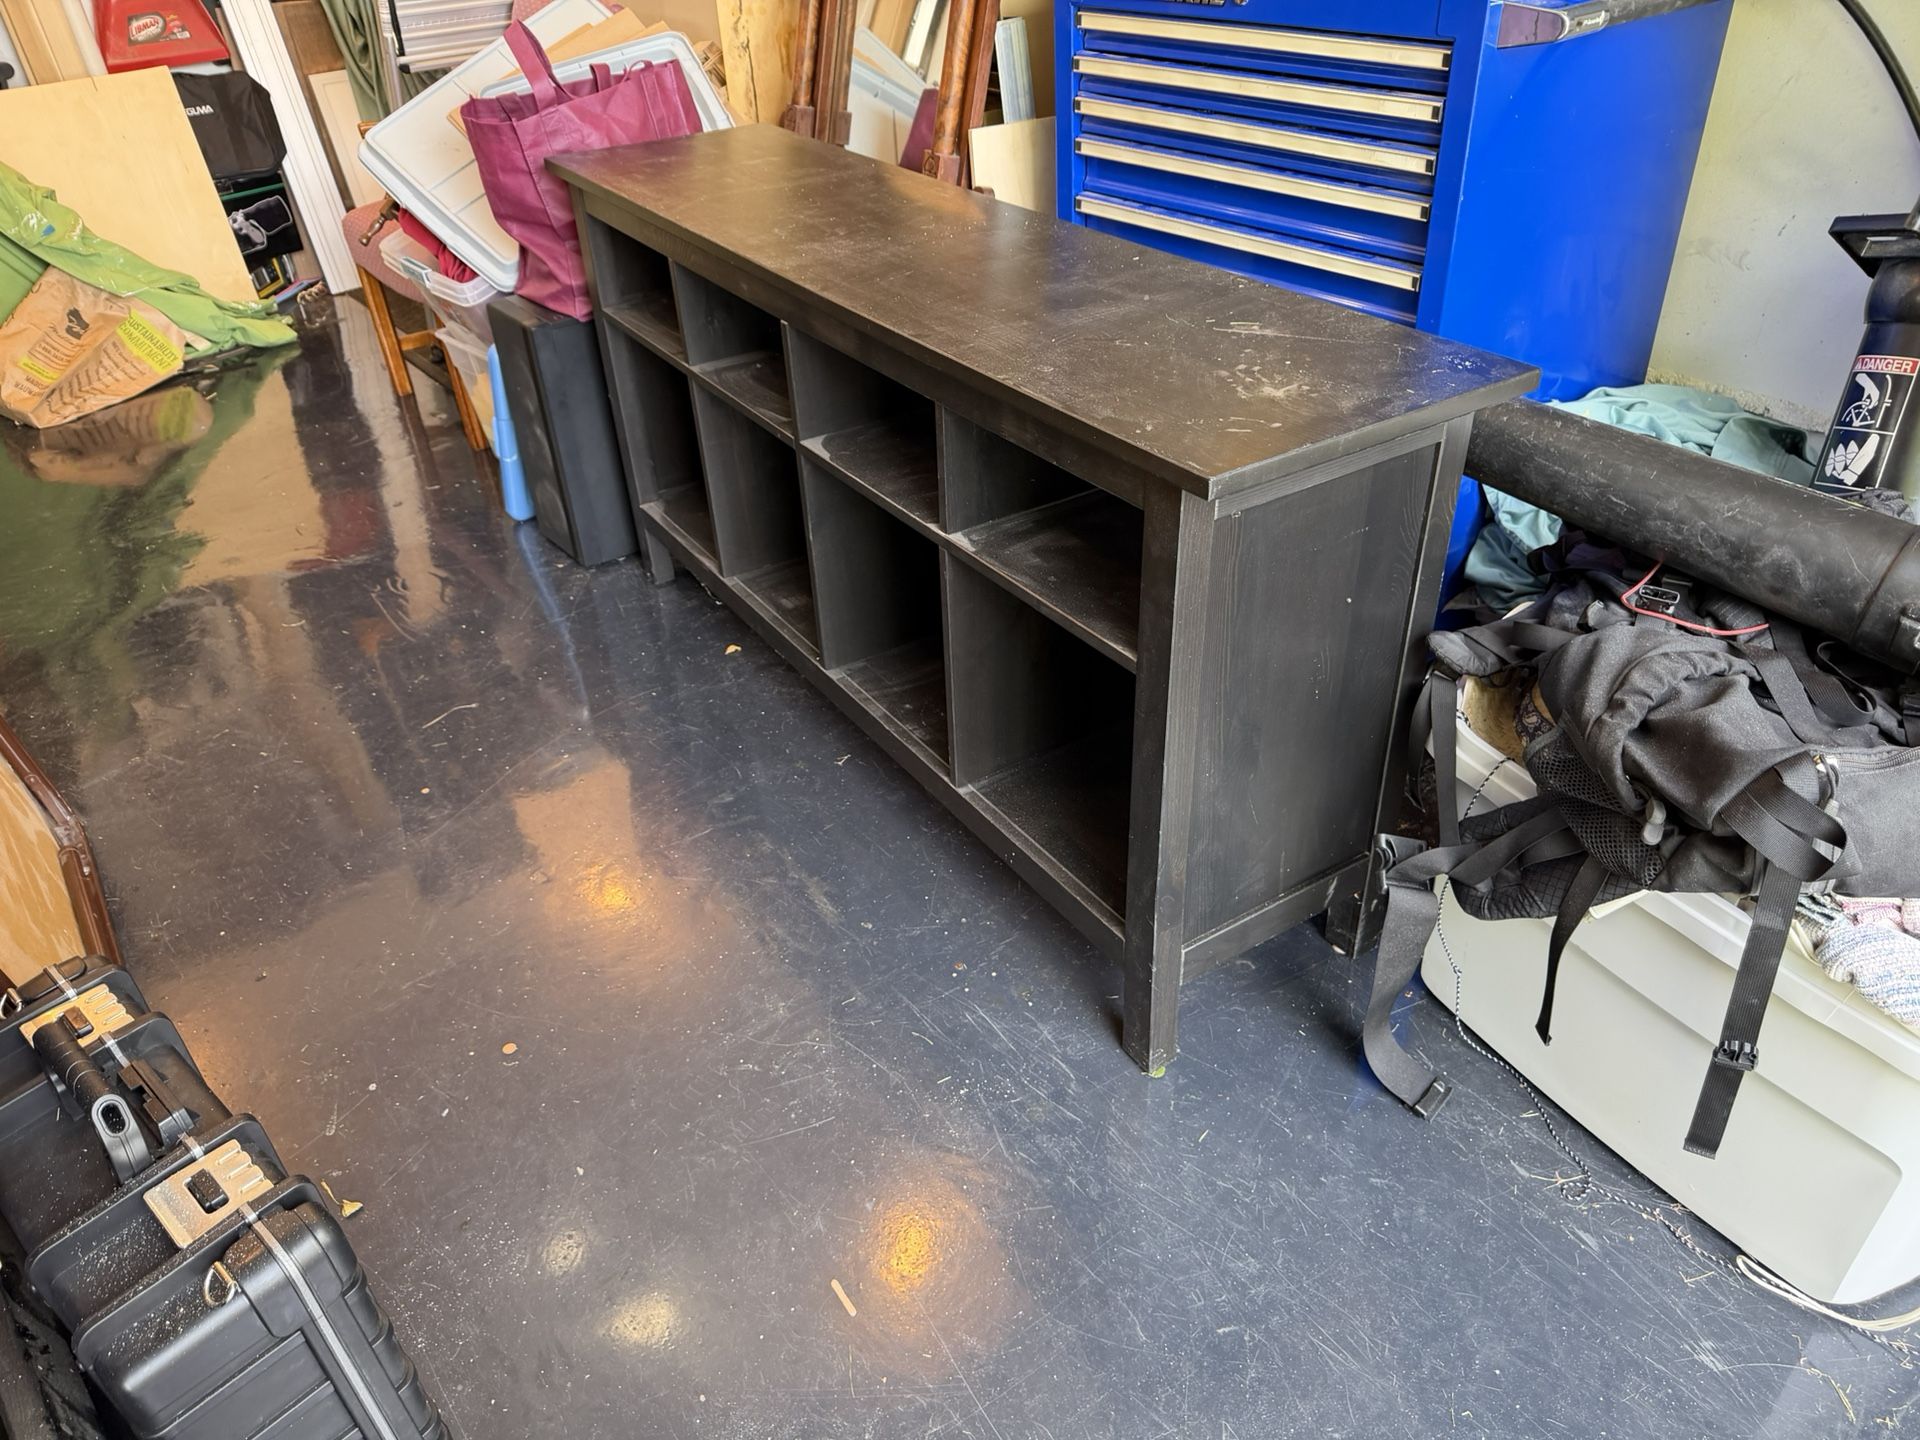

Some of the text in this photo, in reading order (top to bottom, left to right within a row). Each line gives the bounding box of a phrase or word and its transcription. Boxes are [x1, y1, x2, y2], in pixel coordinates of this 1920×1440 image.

[129, 18, 160, 39] LIBMAN
[118, 321, 172, 370] COMMITMENT
[1862, 358, 1913, 373] DANGER
